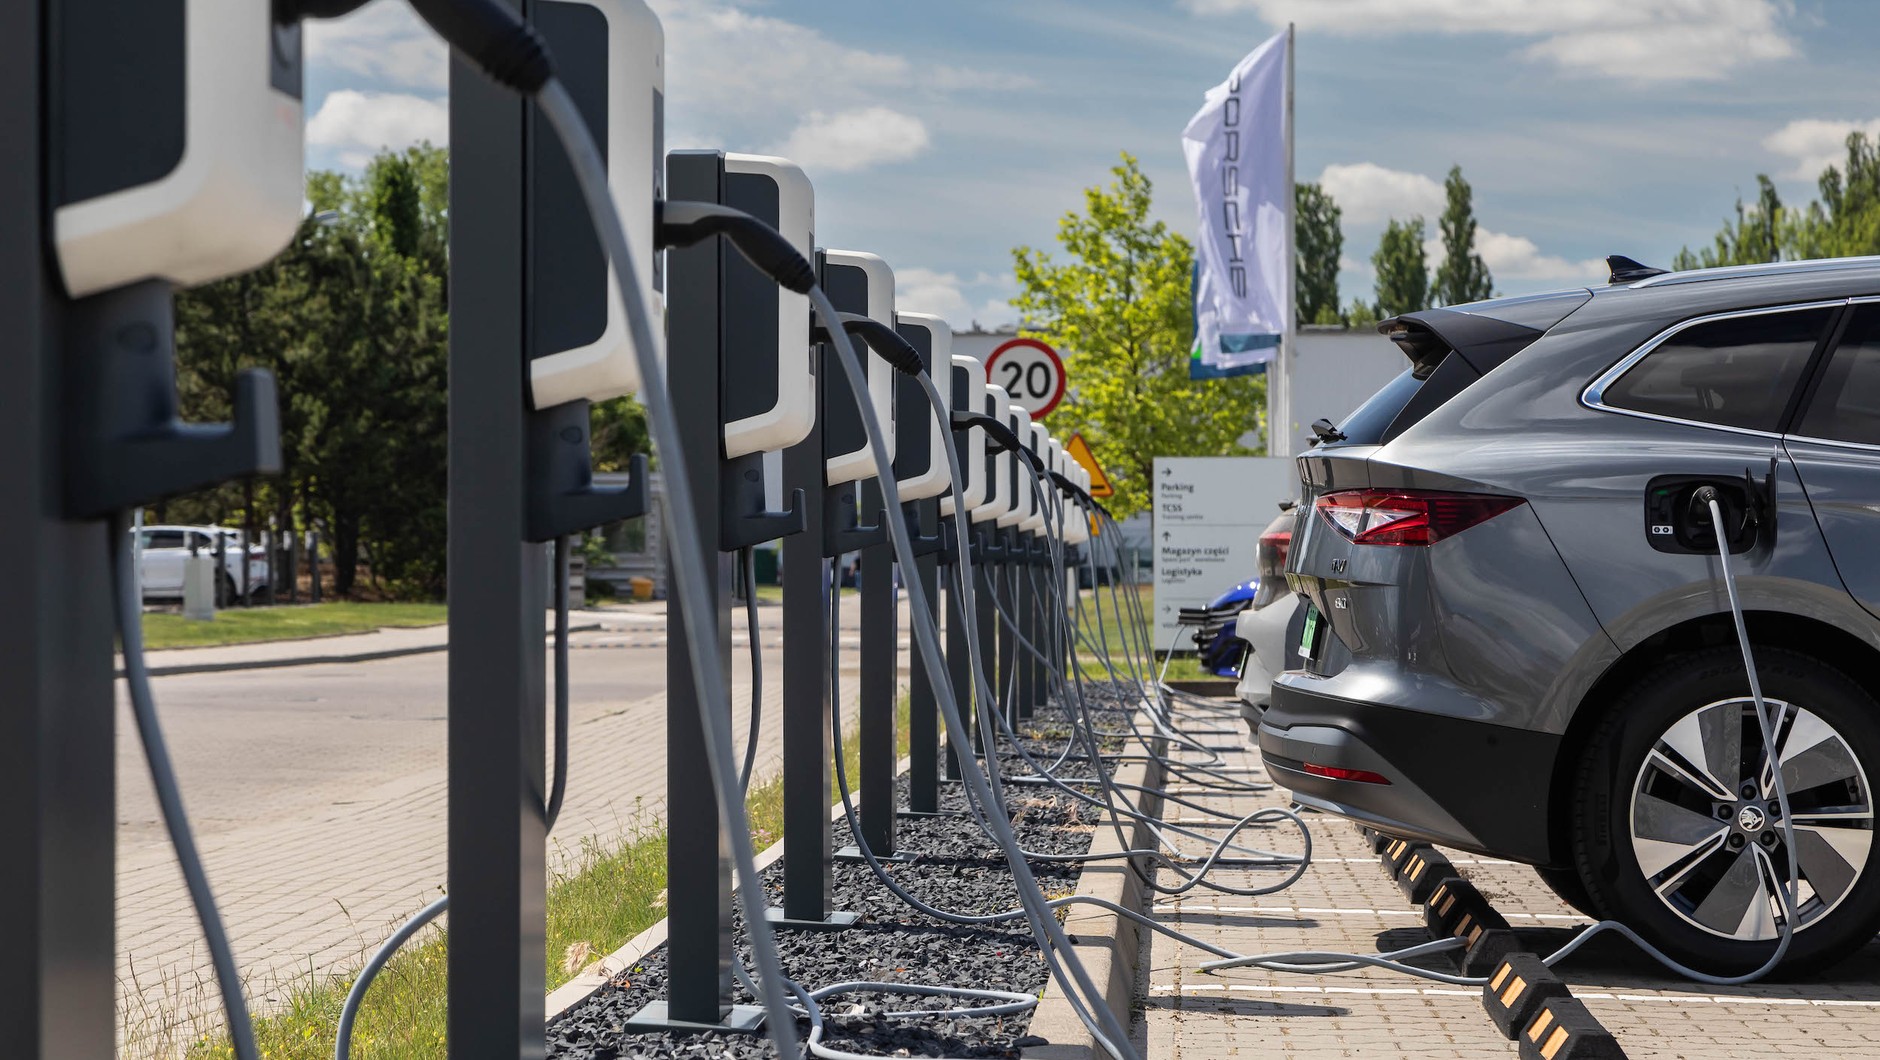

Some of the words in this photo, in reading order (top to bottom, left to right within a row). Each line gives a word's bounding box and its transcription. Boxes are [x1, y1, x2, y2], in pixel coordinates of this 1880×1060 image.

[1001, 361, 1051, 399] 20
[1161, 483, 1194, 493] Parking
[1161, 547, 1202, 556] Magazyn
[1161, 568, 1202, 577] Logistyka
